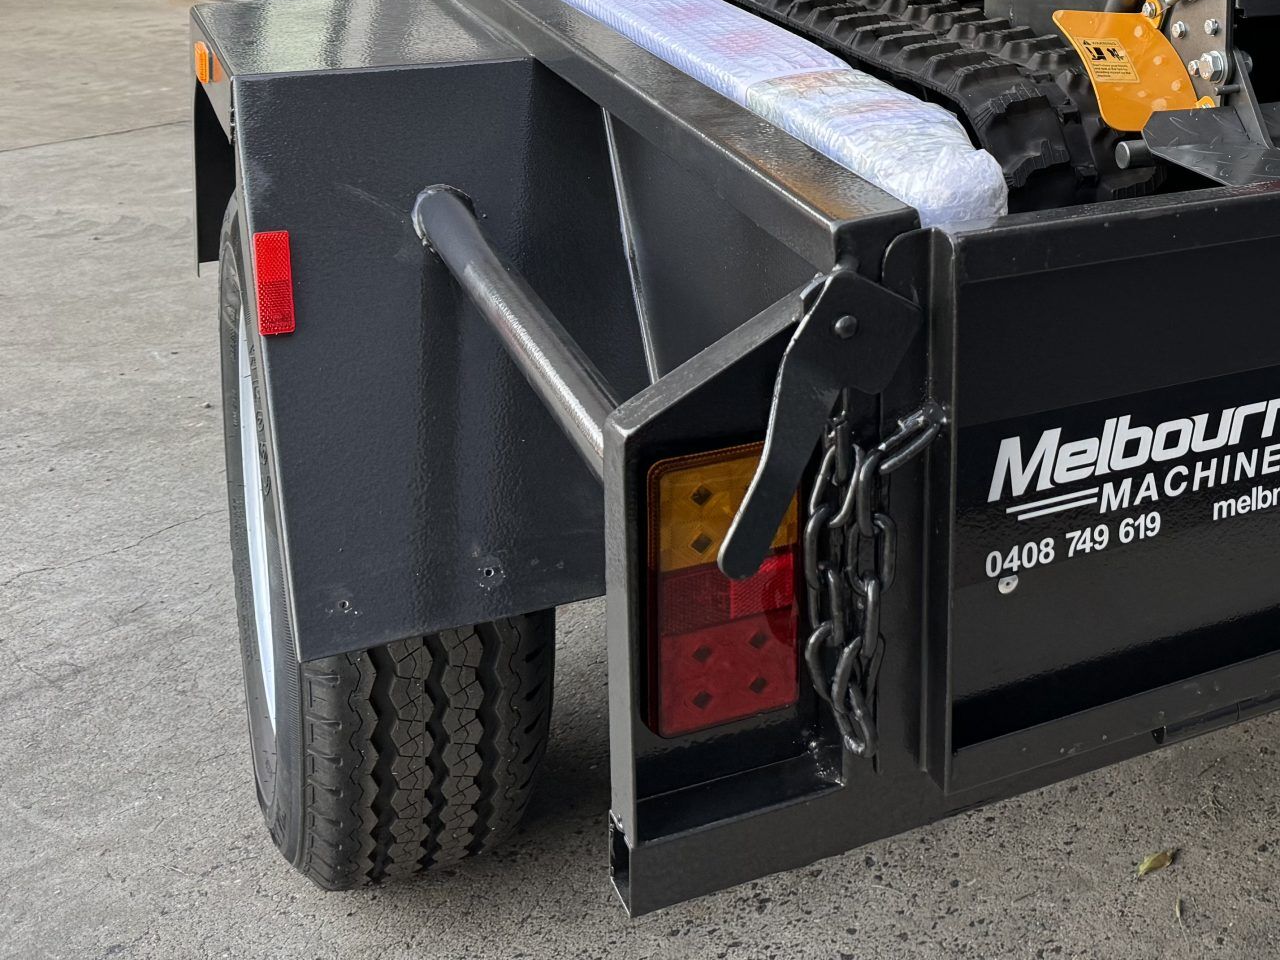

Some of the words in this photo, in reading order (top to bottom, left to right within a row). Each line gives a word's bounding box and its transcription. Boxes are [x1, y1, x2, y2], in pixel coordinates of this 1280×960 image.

[985, 537, 1056, 578] 0408
[1066, 525, 1109, 558] 749
[1118, 511, 1161, 546] 619
